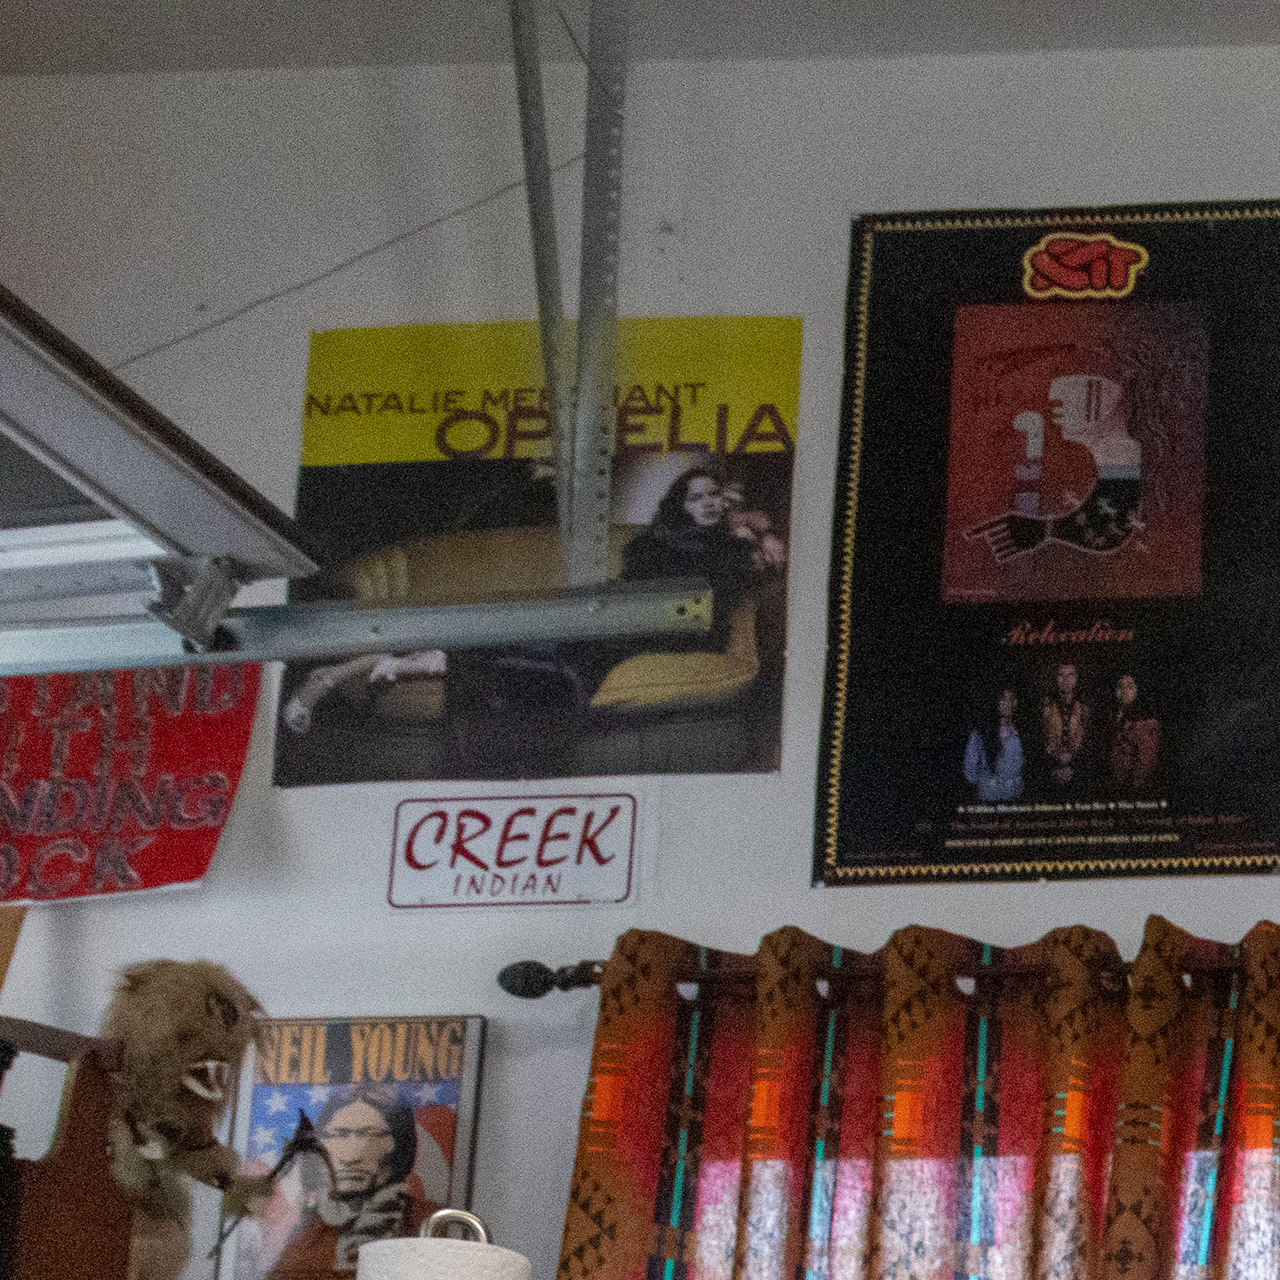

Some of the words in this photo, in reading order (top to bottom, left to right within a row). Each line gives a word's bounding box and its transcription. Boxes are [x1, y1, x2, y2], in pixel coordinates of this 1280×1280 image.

[305, 390, 467, 417] NATALIE
[481, 382, 708, 410] MERANT
[434, 402, 798, 463] OPELIA
[404, 804, 621, 872] CREEK
[452, 872, 563, 898] INDIAN
[258, 1021, 331, 1085] NEIL
[349, 1020, 465, 1083] YOUNG
